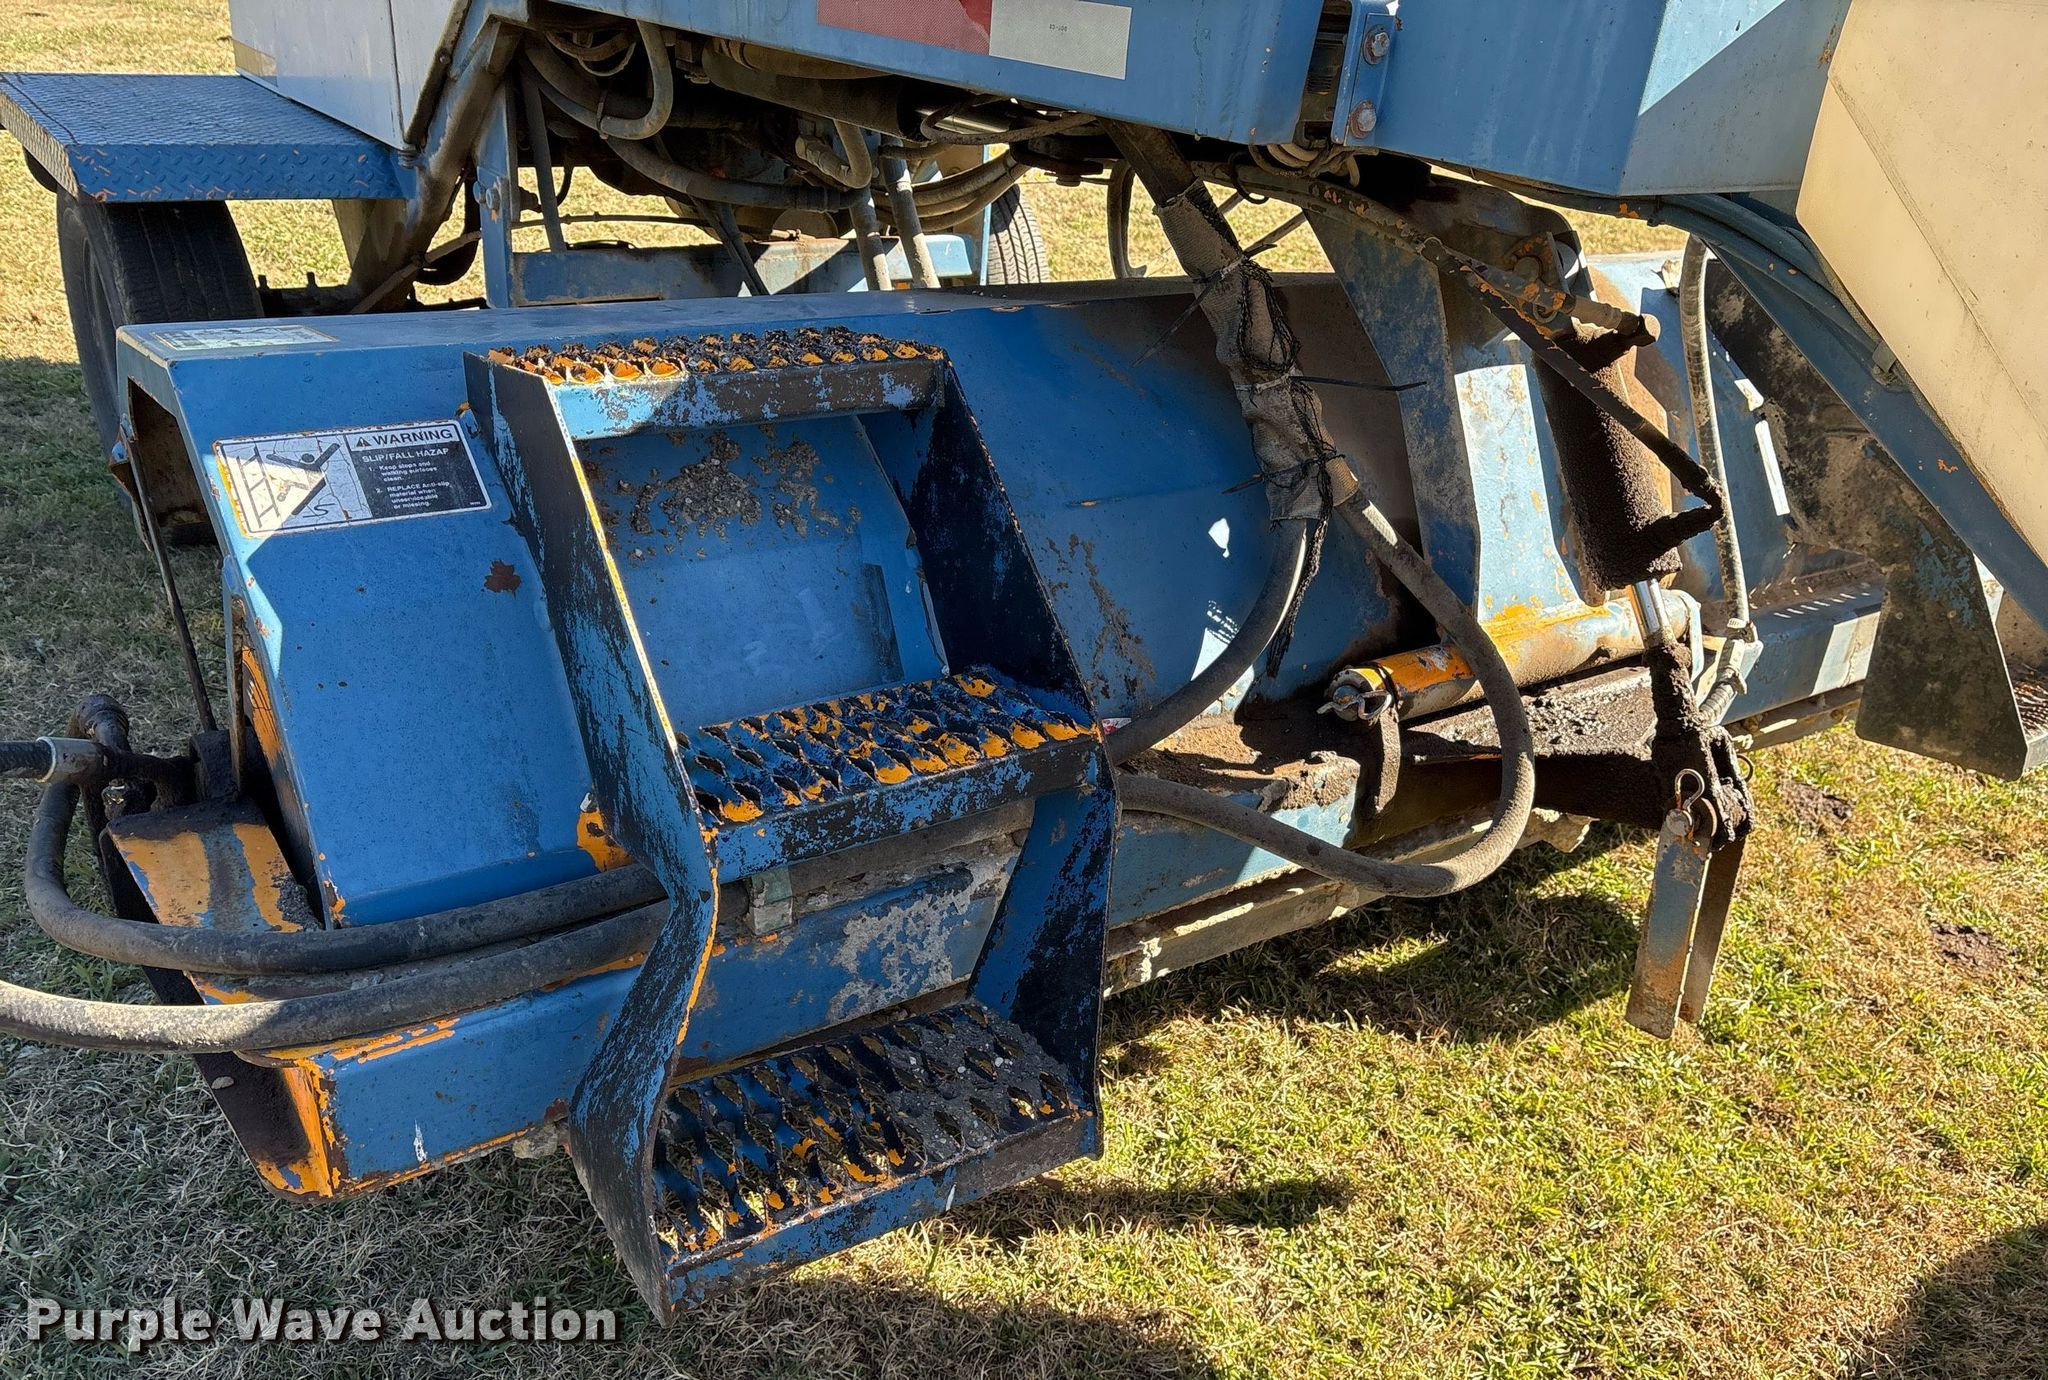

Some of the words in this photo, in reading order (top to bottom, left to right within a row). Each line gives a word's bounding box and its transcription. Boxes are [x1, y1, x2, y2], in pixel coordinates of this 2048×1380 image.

[372, 429, 453, 446] WARNING
[362, 452, 415, 463] SLIP/FALL
[381, 469, 408, 477] walking
[409, 466, 438, 474] surfaces
[387, 483, 421, 493] REPLACE
[389, 490, 417, 498] material
[418, 488, 437, 496] when
